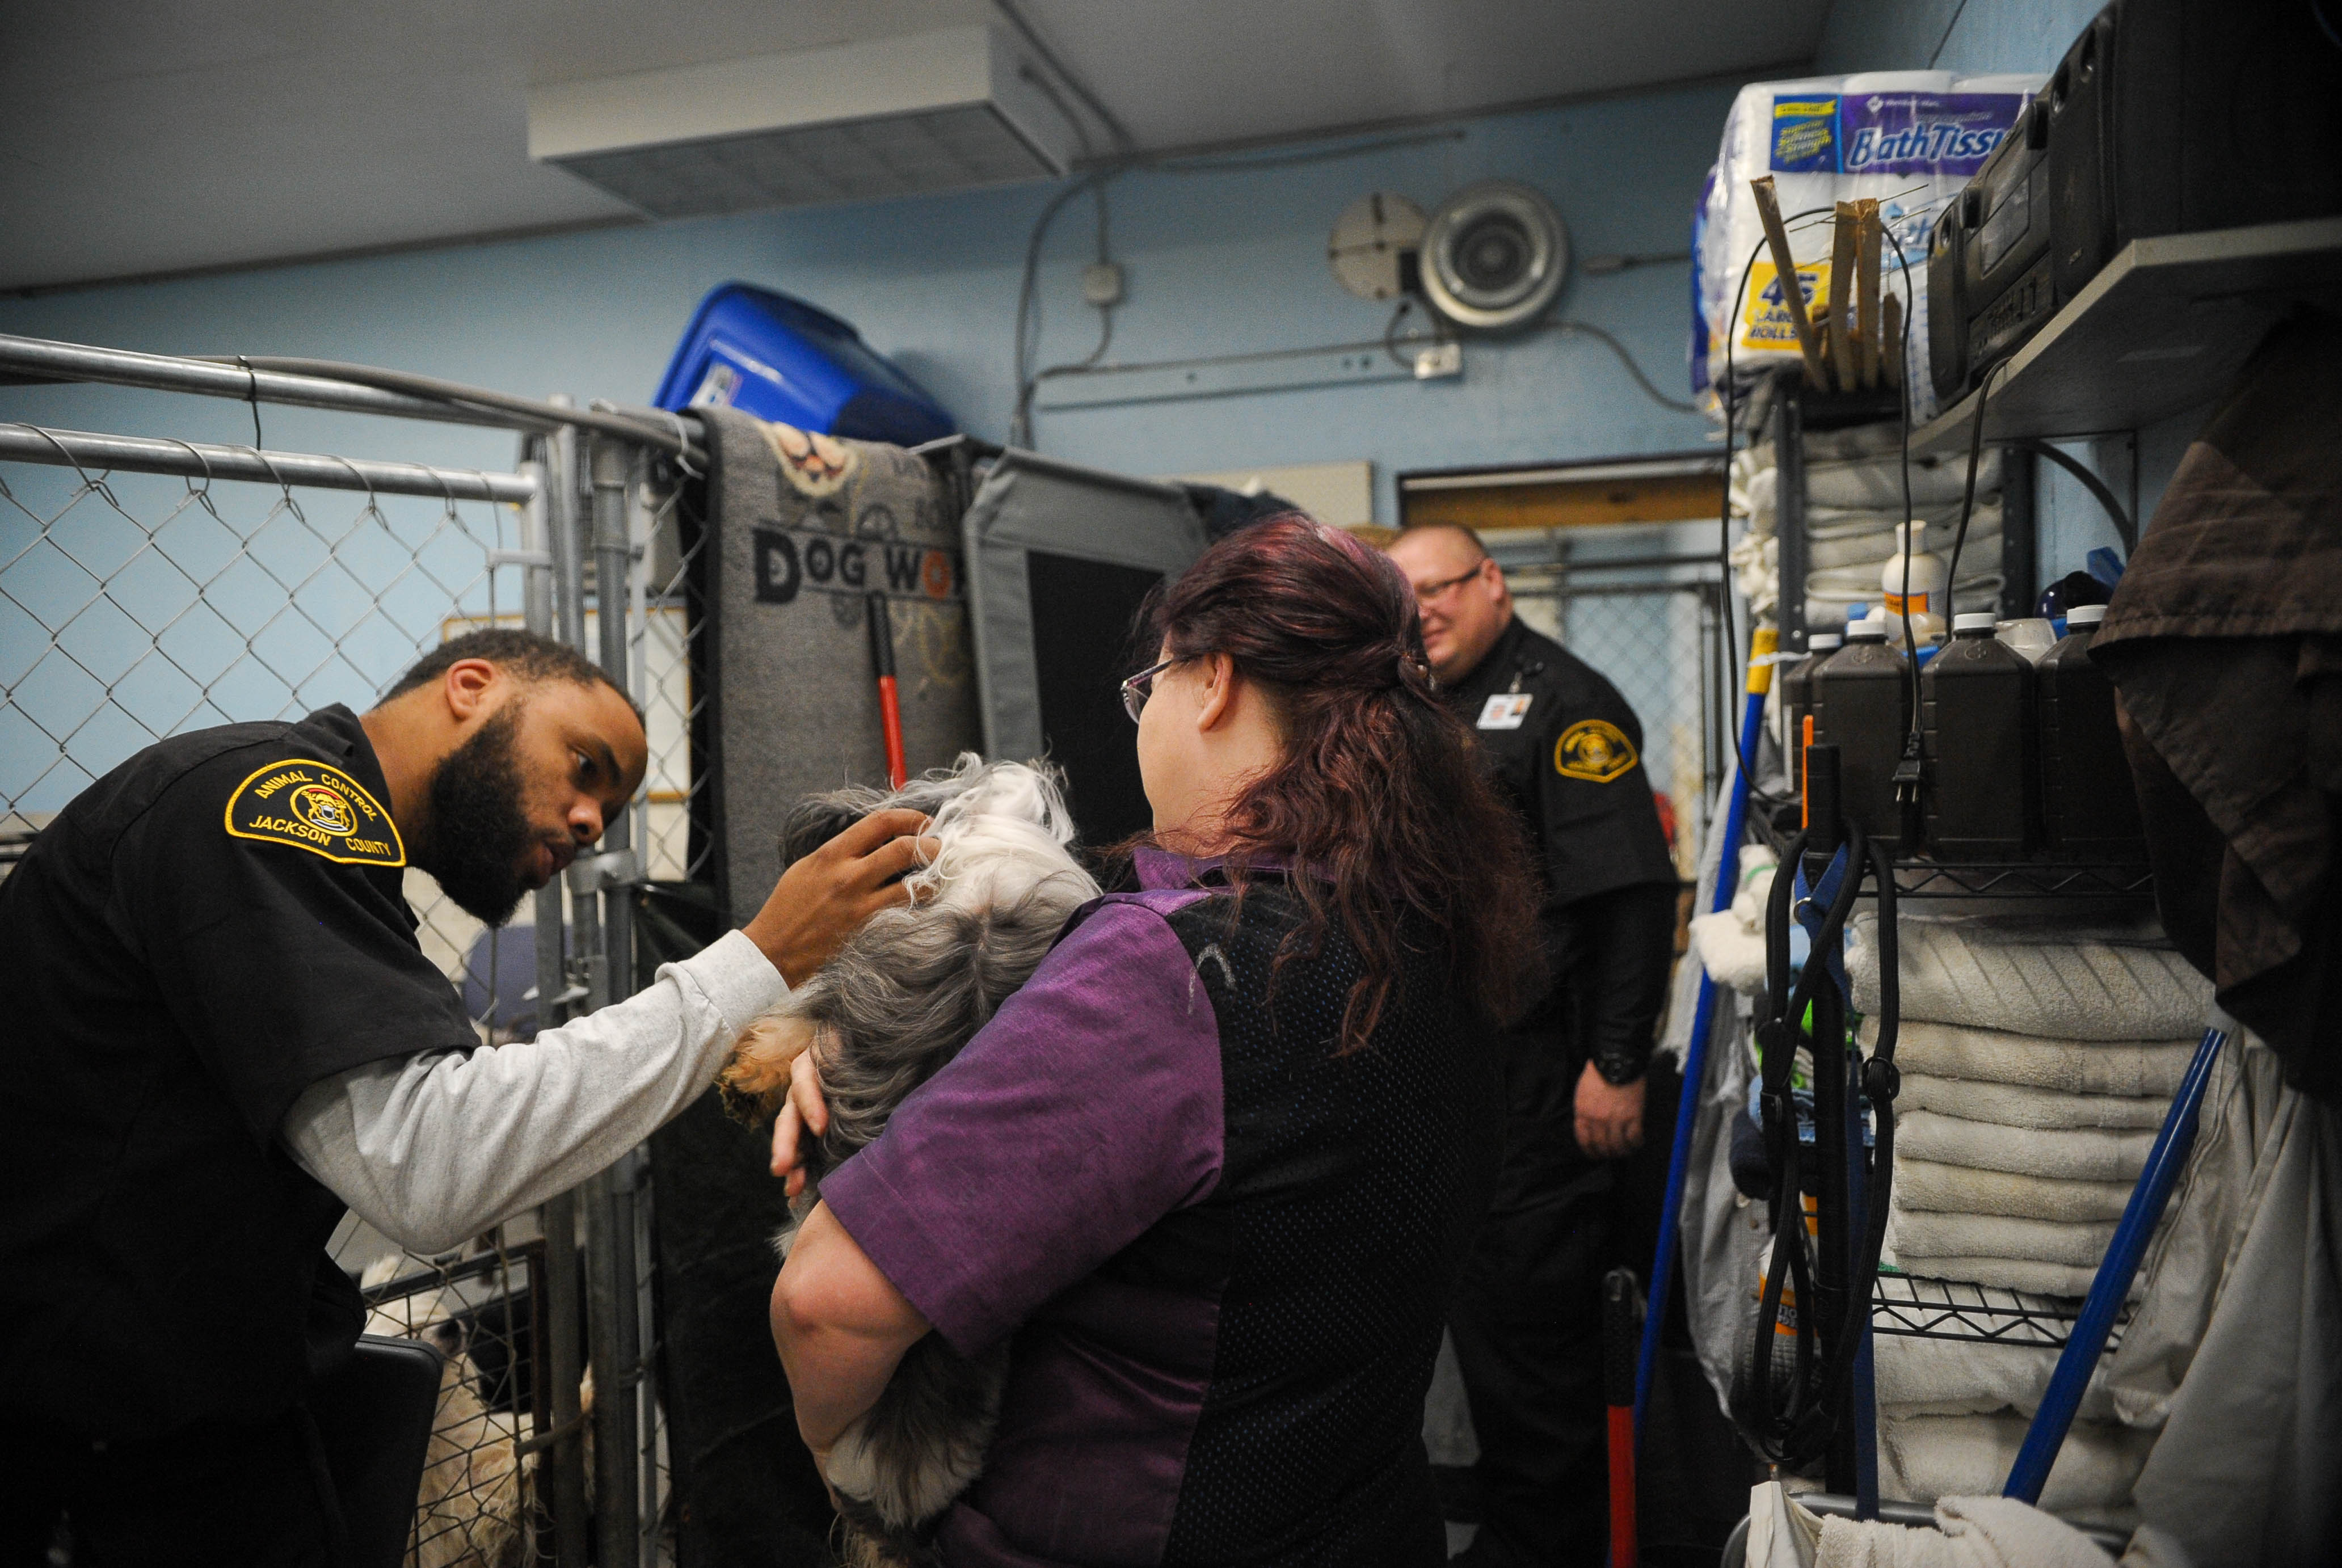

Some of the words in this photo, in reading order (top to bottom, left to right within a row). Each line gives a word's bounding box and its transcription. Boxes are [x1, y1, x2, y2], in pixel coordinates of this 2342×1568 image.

[752, 528, 865, 604] DOG
[254, 771, 313, 799] ANIMAL
[321, 774, 378, 821] CONTROL
[249, 815, 331, 846] JACKSON
[345, 837, 391, 856] COUNTY
